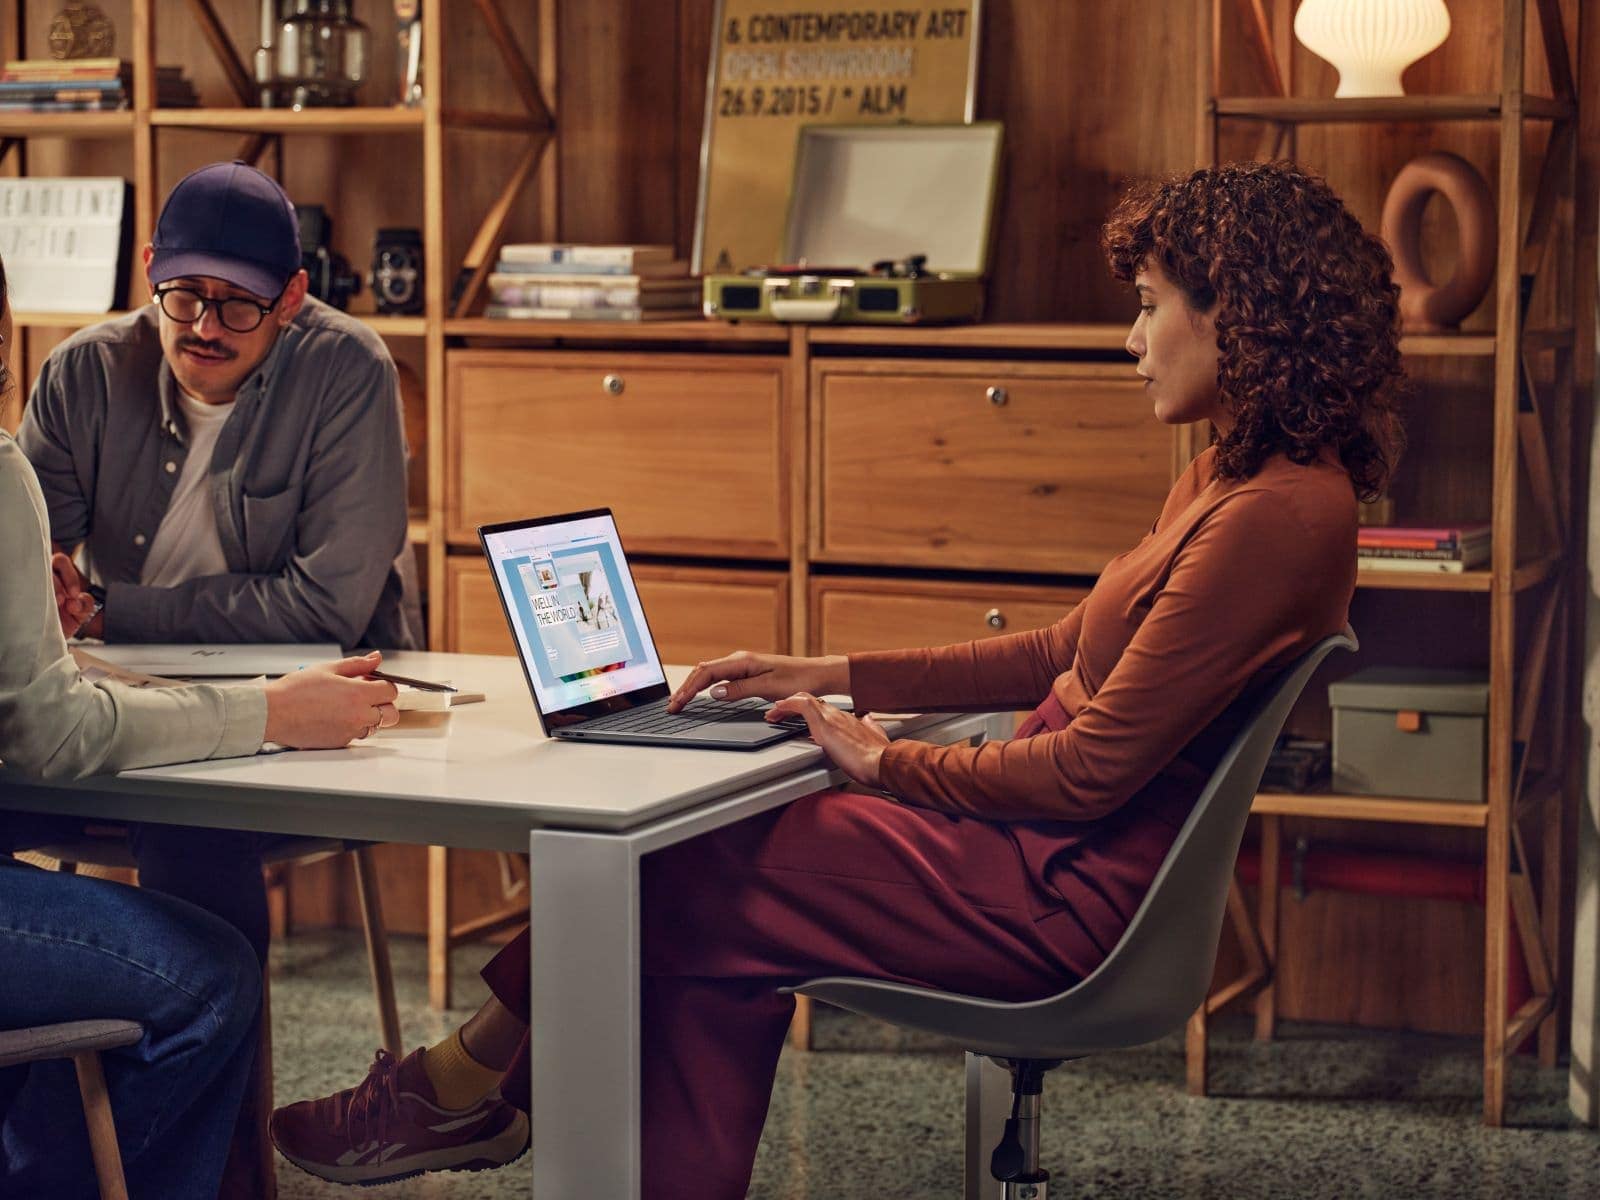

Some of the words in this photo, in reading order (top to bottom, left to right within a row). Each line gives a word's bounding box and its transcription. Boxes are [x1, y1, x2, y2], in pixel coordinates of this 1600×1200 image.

[726, 18, 741, 44] &
[748, 10, 921, 43] CONTEMPORARY
[925, 10, 969, 40] ART
[724, 50, 778, 81] OPEN
[719, 86, 821, 117] 26.9.2015
[858, 86, 907, 114] ALM
[537, 611, 553, 625] THE
[550, 607, 577, 622] WORLD
